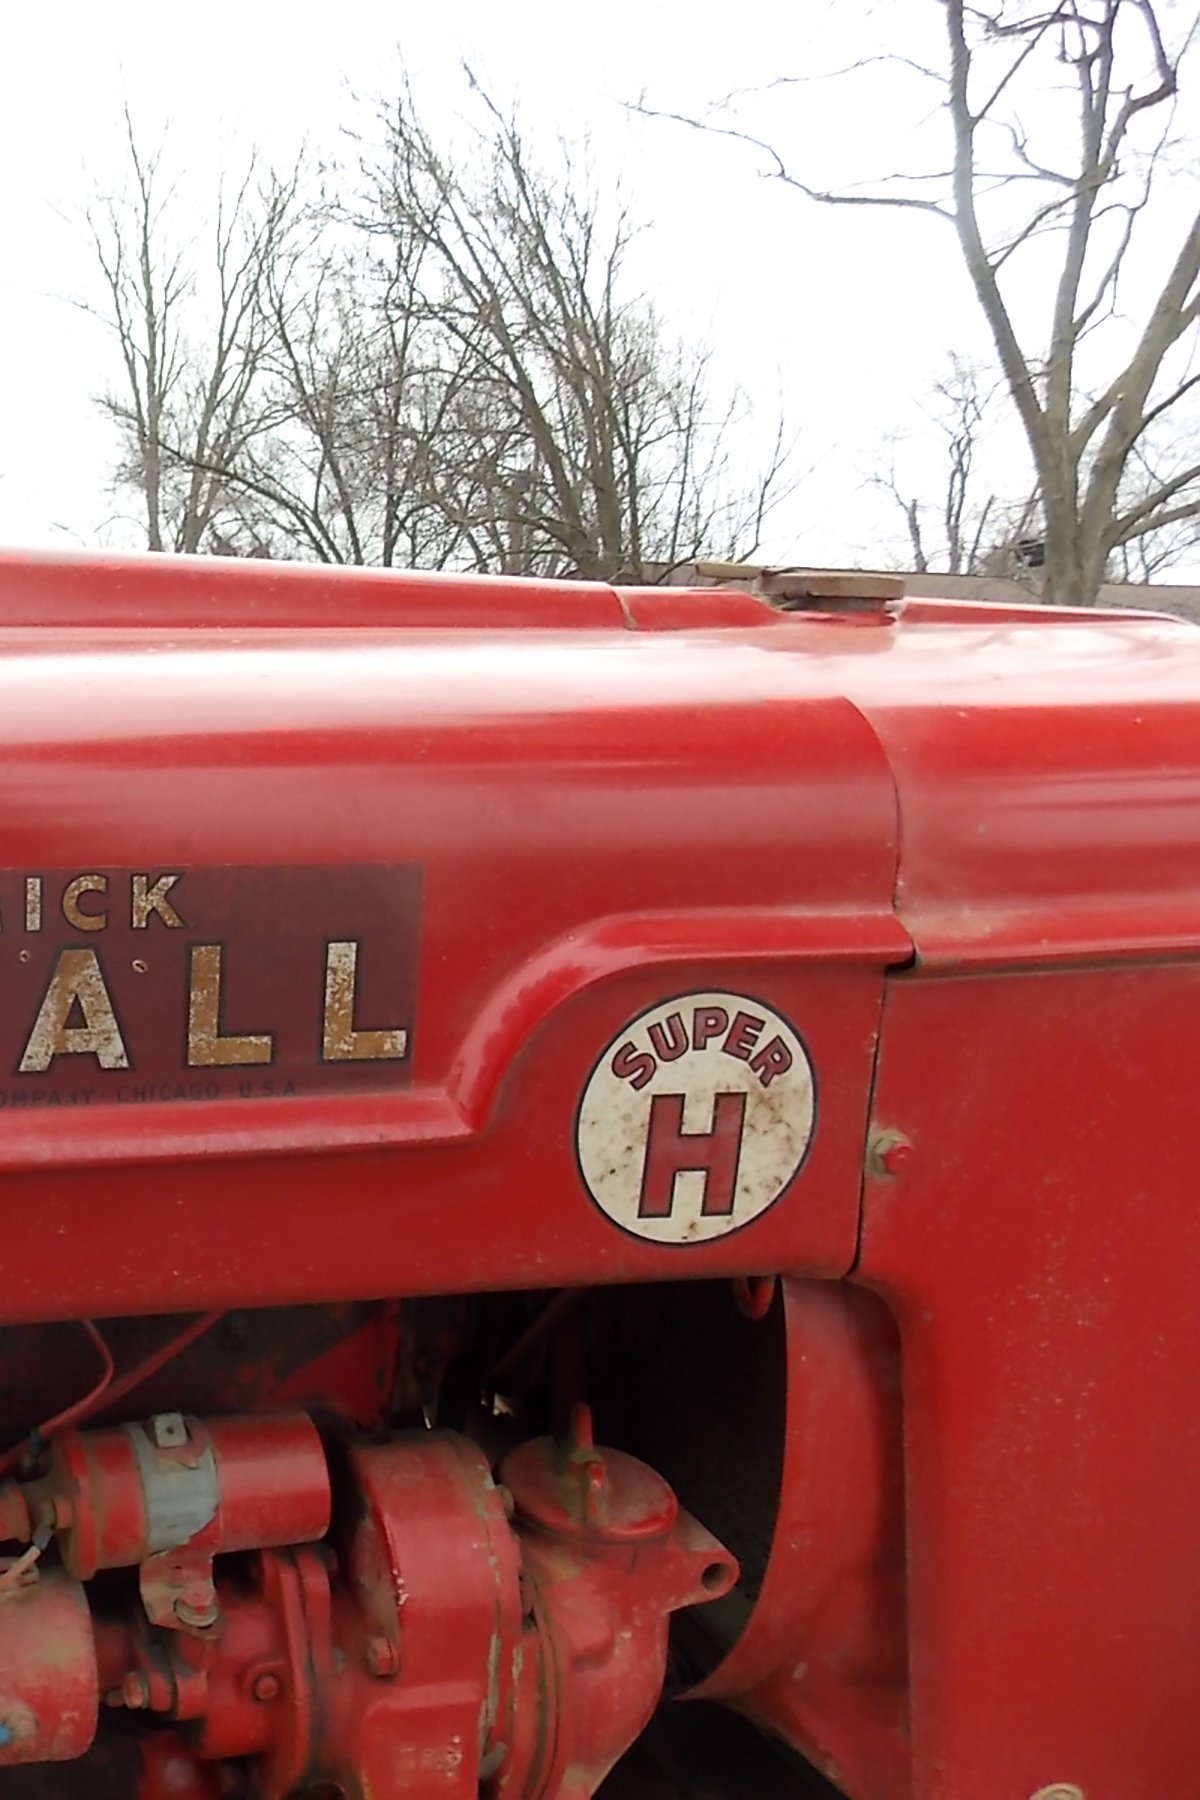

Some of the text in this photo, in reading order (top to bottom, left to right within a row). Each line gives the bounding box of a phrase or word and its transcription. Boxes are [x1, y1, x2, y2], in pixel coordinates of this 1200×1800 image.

[611, 1006, 793, 1091] SUPER
[116, 1081, 220, 1103] CHICAGO
[637, 1092, 748, 1219] H
